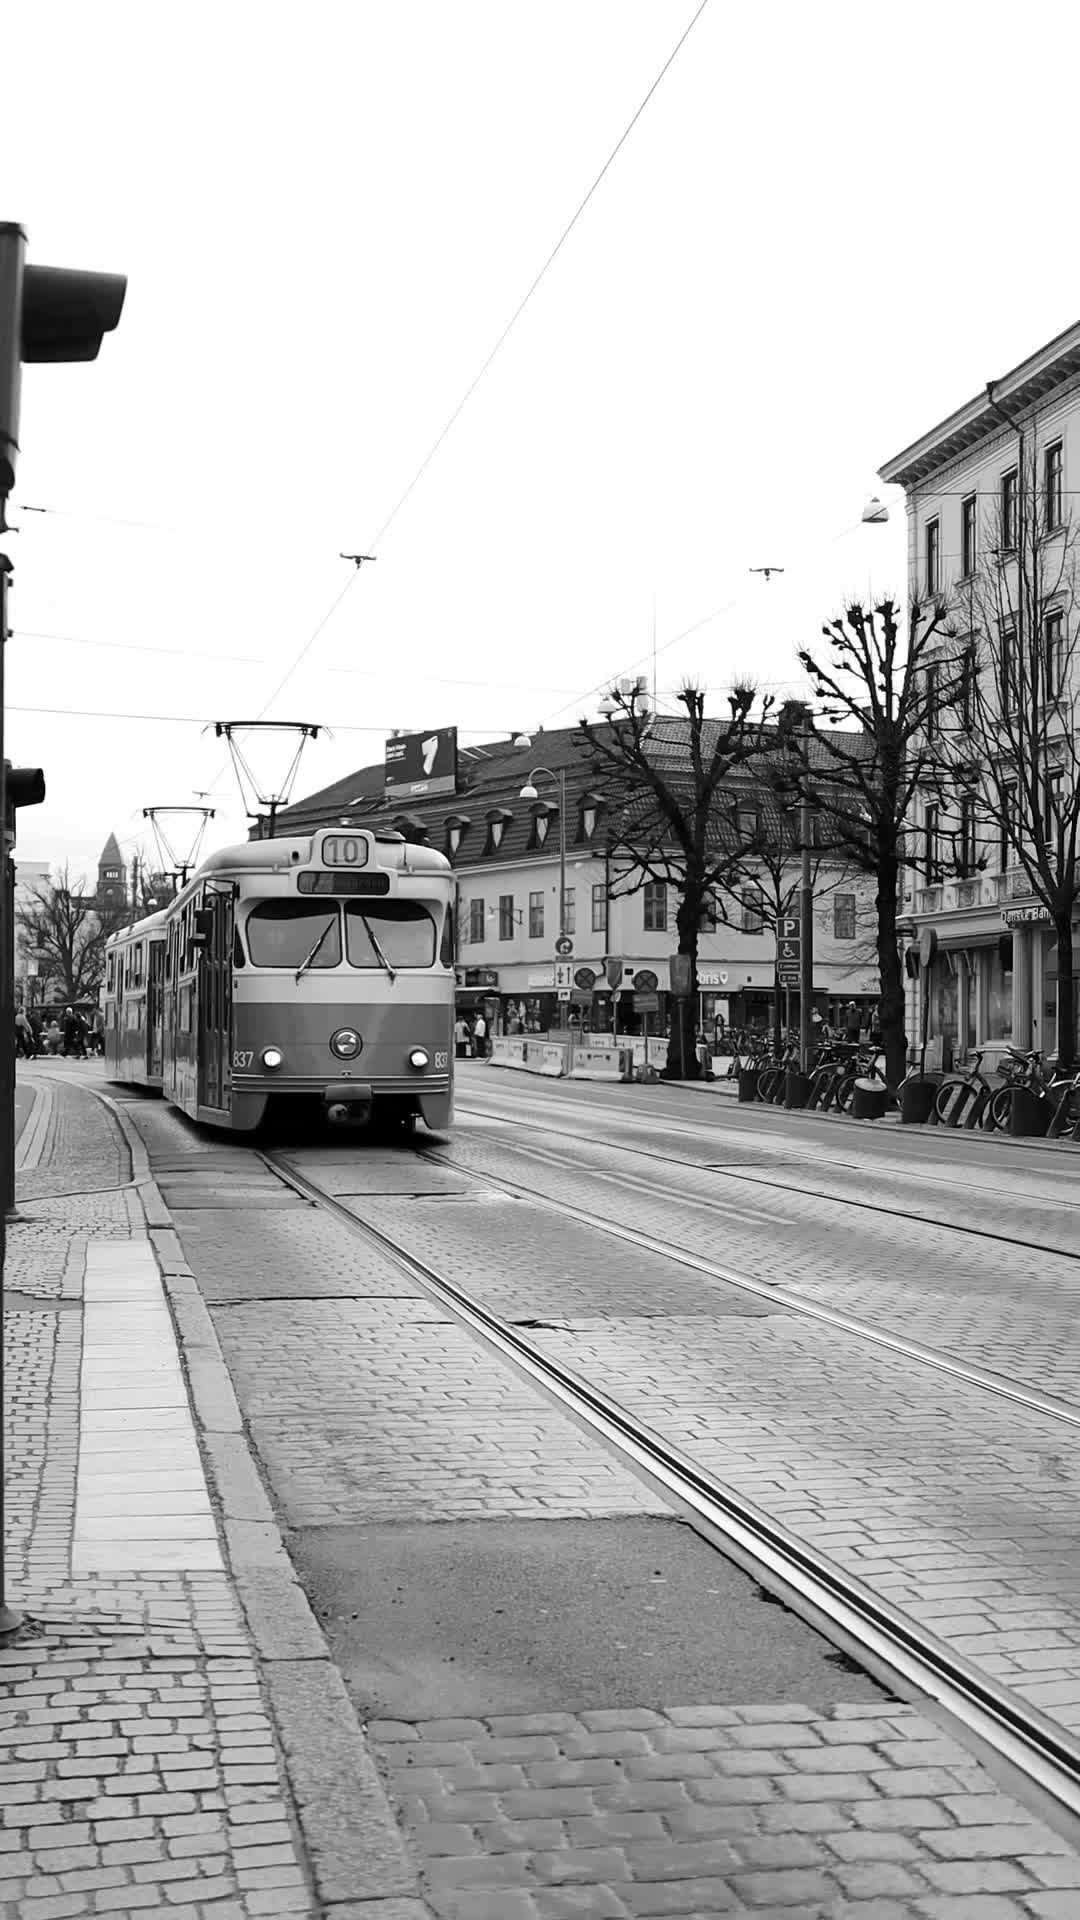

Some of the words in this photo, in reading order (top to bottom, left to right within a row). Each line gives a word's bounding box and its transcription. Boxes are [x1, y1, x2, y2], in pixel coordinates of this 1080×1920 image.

[328, 839, 358, 864] 10
[783, 920, 795, 937] P
[233, 1051, 253, 1068] 837
